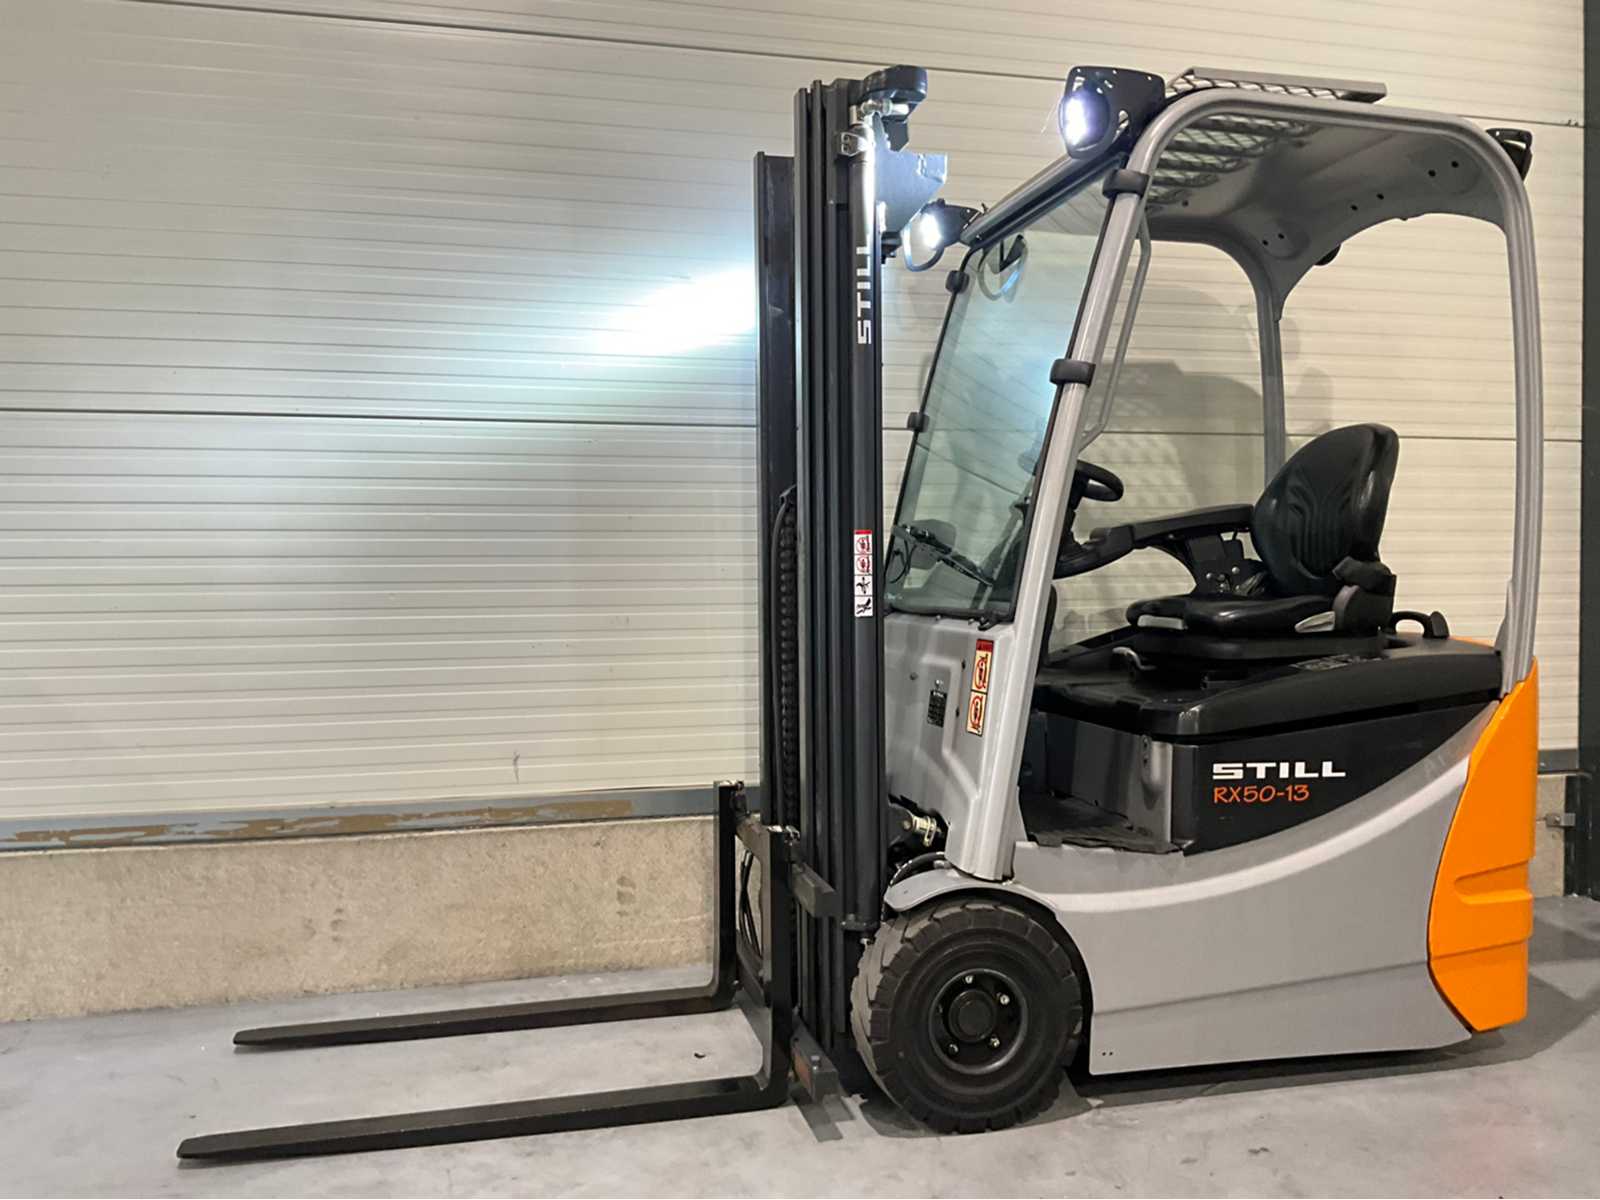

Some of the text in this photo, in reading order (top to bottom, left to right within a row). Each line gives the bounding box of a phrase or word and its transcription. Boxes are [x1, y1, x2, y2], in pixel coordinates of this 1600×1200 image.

[856, 234, 871, 344] STILL
[1212, 761, 1346, 779] STILL
[1214, 784, 1310, 803] RX50-13
